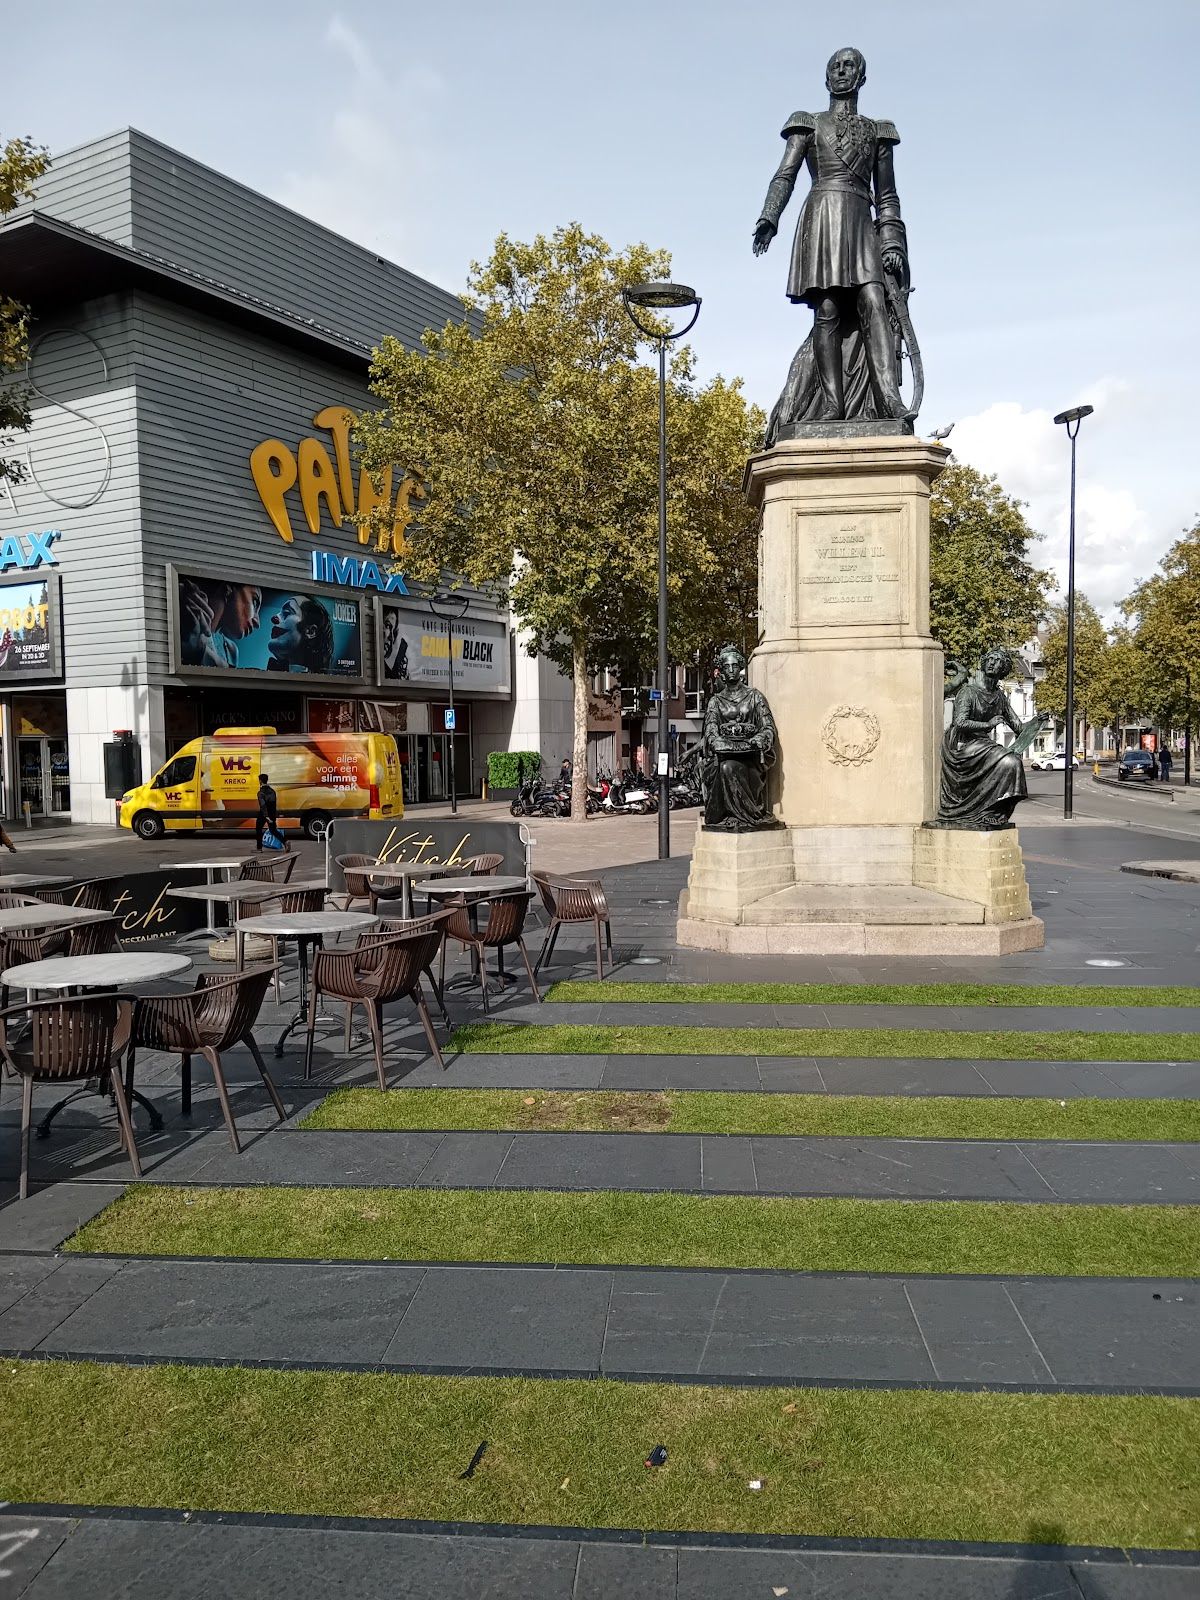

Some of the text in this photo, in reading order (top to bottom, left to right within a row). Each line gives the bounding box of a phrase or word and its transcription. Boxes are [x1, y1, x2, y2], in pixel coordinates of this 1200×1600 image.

[815, 547, 867, 559] WILLEM
[312, 550, 410, 595] IMAX
[333, 602, 357, 623] JOKER
[421, 620, 437, 632] KATE
[14, 645, 22, 653] 26
[463, 639, 494, 663] BLACK
[220, 756, 252, 770] VHC
[336, 754, 358, 763] alles
[316, 765, 358, 773] voor een
[321, 773, 358, 783] slimme
[333, 782, 357, 791] zaak
[165, 792, 182, 800] VHC
[371, 826, 476, 881] Kitch
